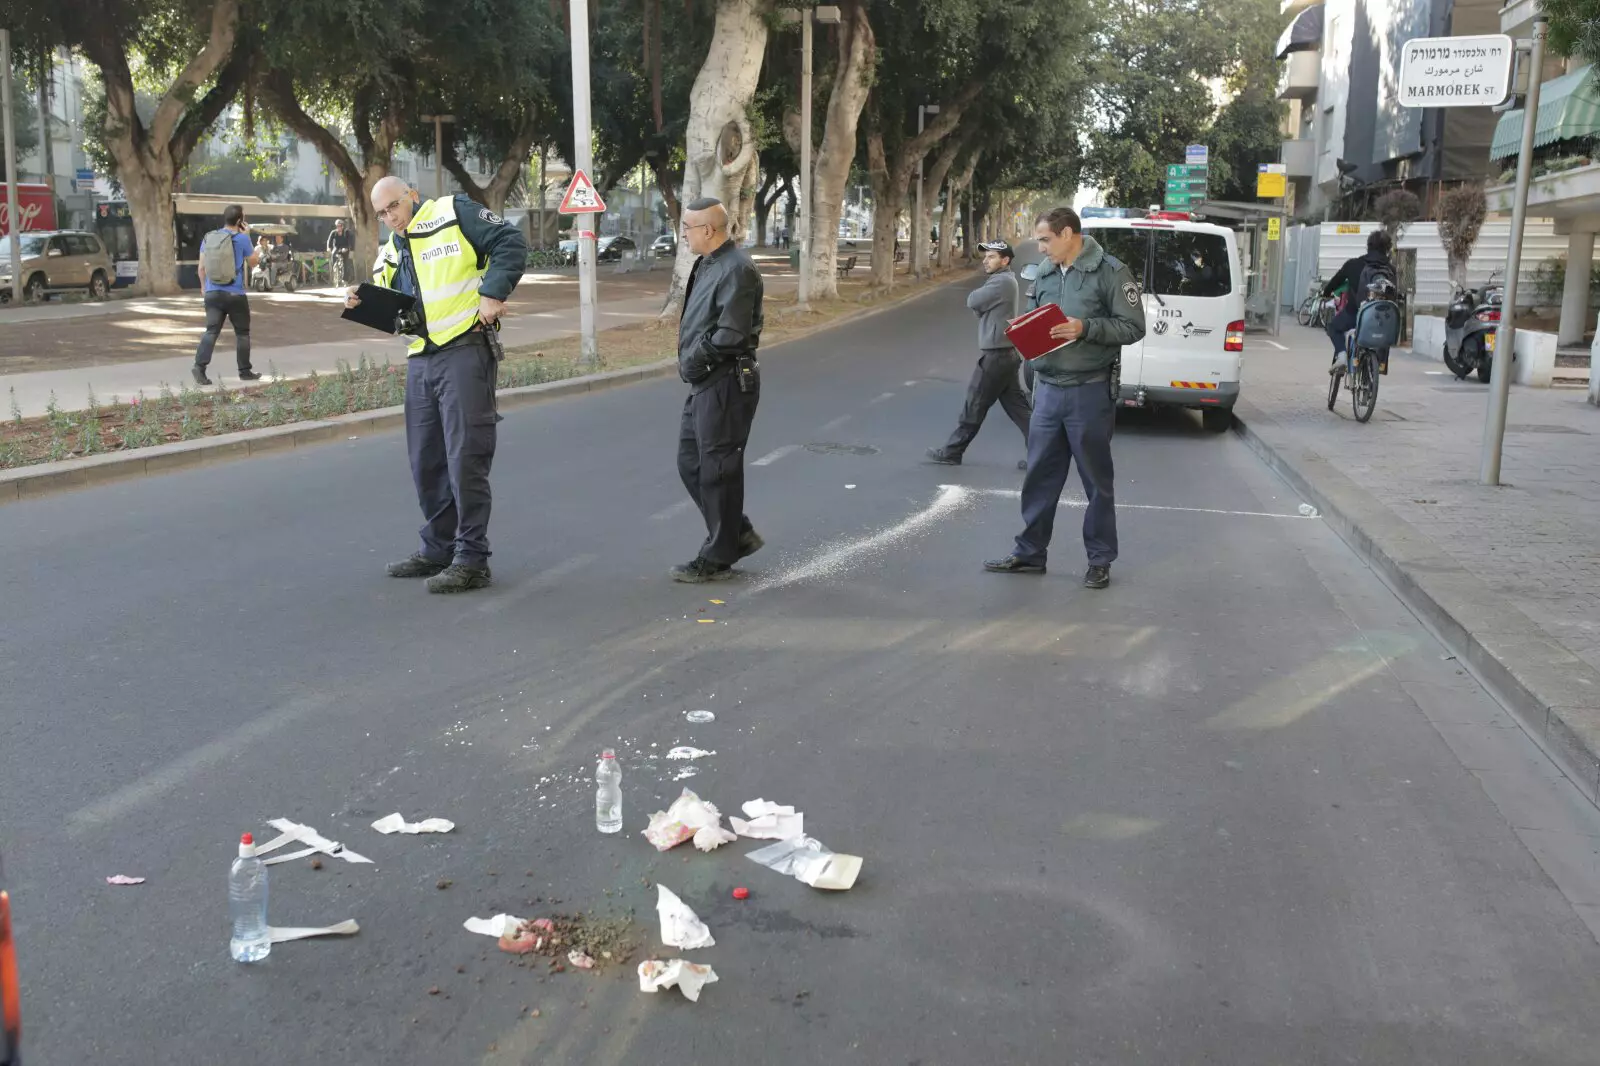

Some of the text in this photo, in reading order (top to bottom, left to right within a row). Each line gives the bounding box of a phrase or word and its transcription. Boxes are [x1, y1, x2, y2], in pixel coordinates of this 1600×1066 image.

[1410, 47, 1450, 63] מרמורק
[1453, 45, 1486, 58] אלכסנדר
[1424, 64, 1484, 78] شارع مرمورك
[1407, 84, 1481, 97] MARMOREK
[416, 216, 446, 230] משטרה
[421, 243, 460, 261] בוחן תנועה
[1156, 308, 1183, 319] בוחן
